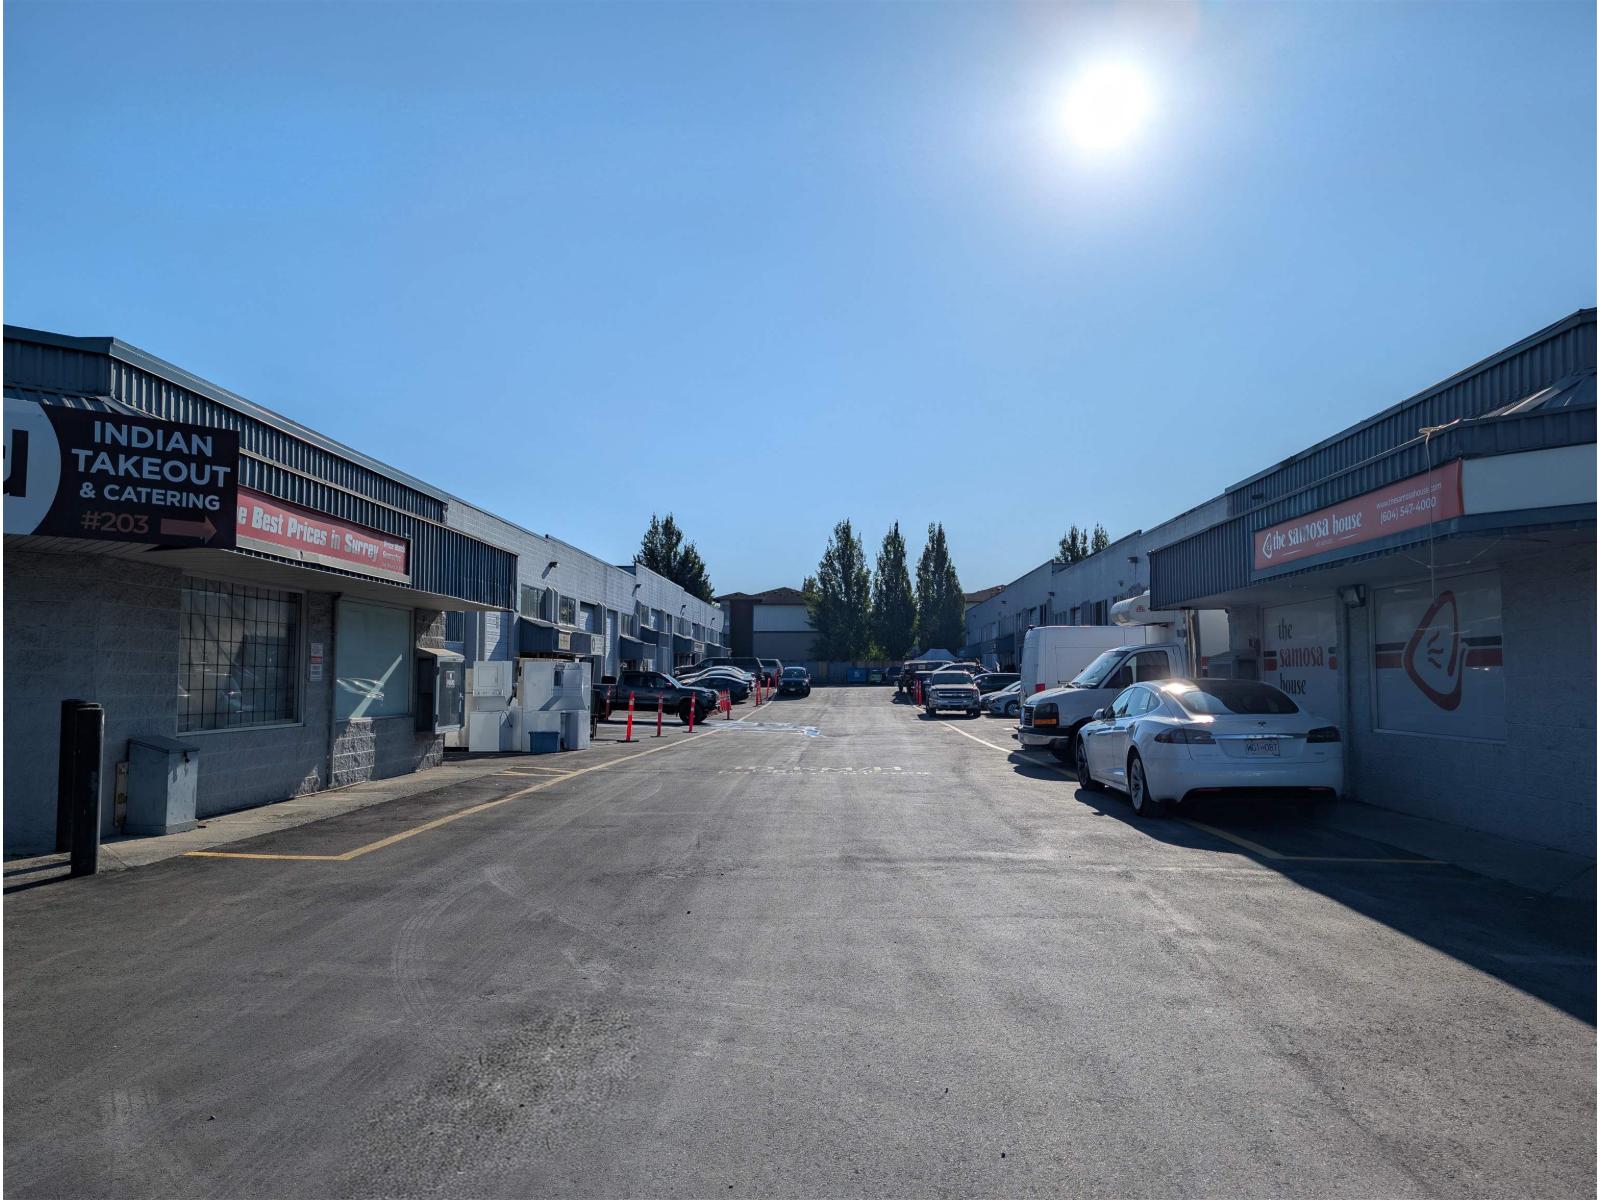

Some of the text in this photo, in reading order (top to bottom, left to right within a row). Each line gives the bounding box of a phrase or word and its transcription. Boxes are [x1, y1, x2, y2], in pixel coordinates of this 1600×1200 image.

[93, 420, 213, 458] INDIAN
[71, 448, 231, 488] TAKEOUT
[79, 481, 221, 511] & CATERING
[80, 510, 149, 535] #203
[1380, 507, 1399, 526] (604)
[251, 505, 284, 536] Best
[286, 516, 328, 546] Prices
[330, 529, 342, 551] in
[344, 532, 379, 562] Surrey
[1273, 511, 1363, 551] the samosa house
[1278, 616, 1293, 641] the
[1279, 646, 1324, 668] samosa
[1279, 672, 1307, 696] house
